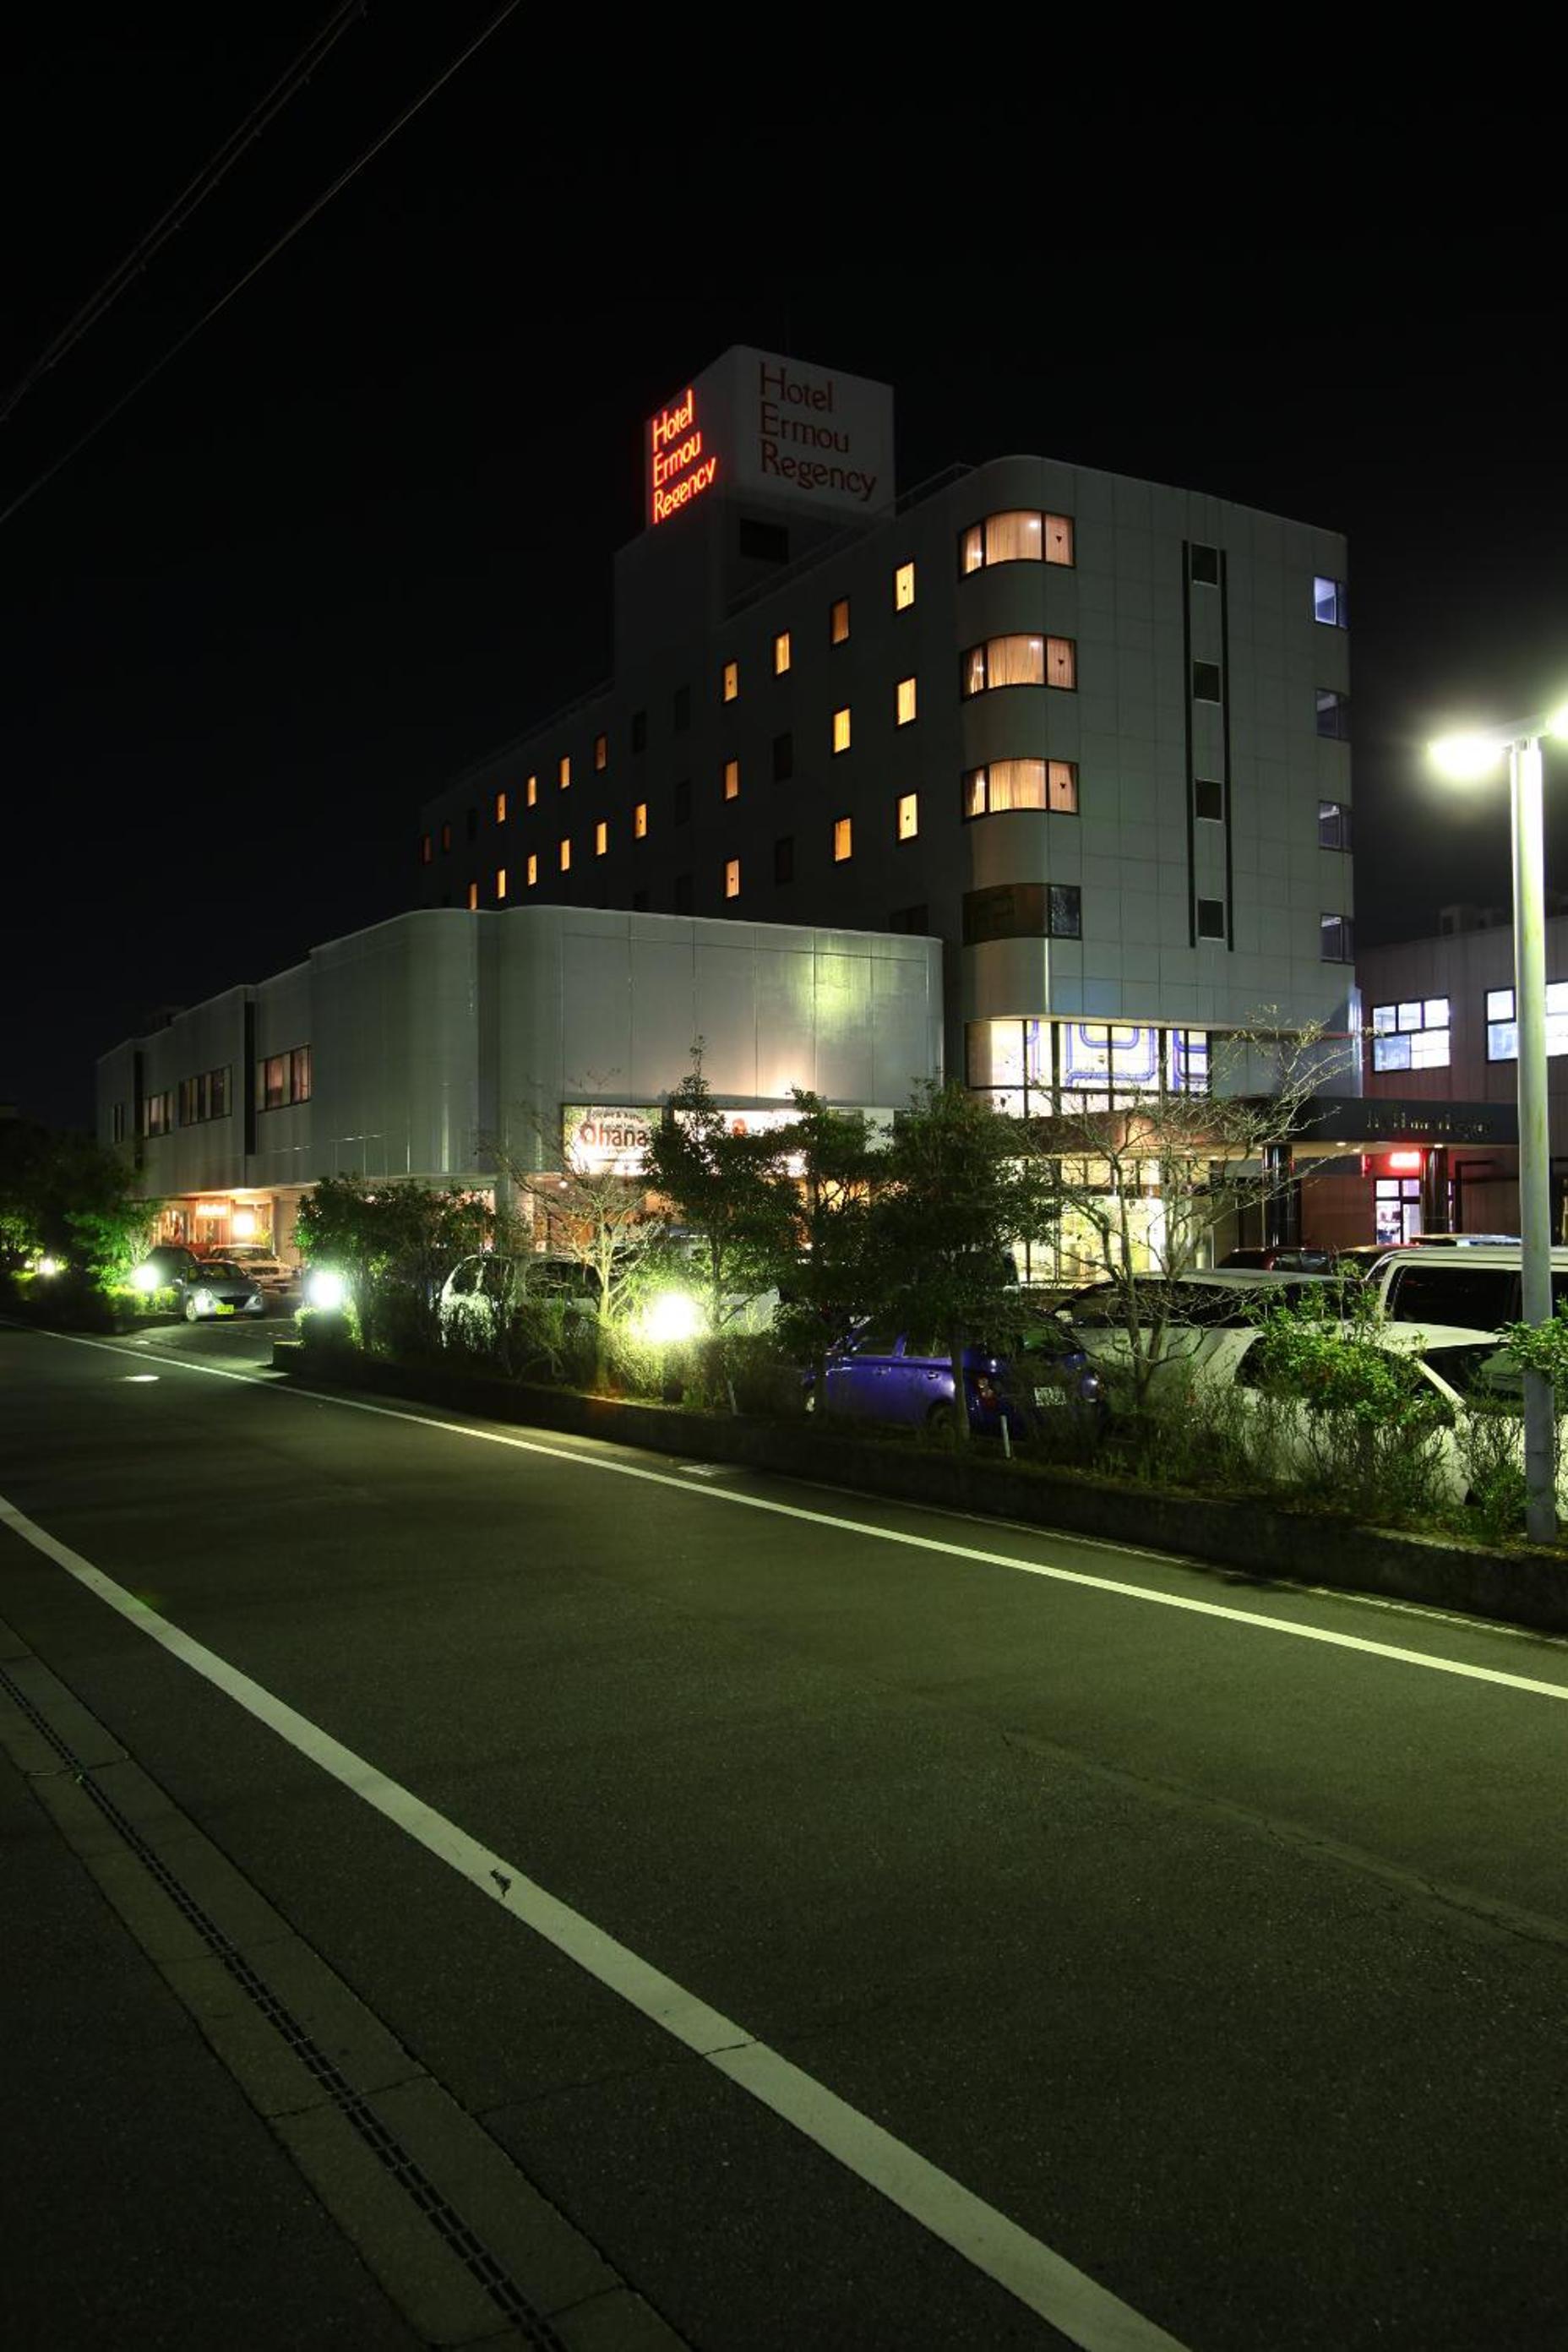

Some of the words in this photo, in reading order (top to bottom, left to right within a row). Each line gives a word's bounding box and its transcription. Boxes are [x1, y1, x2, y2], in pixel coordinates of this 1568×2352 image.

[760, 362, 833, 413] Hotel
[652, 387, 693, 452] Hotel
[761, 401, 849, 454] Ermou
[652, 433, 701, 487] Ermou
[761, 439, 877, 502] Regency
[652, 457, 716, 523] Regency
[580, 1122, 648, 1147] Ohana
